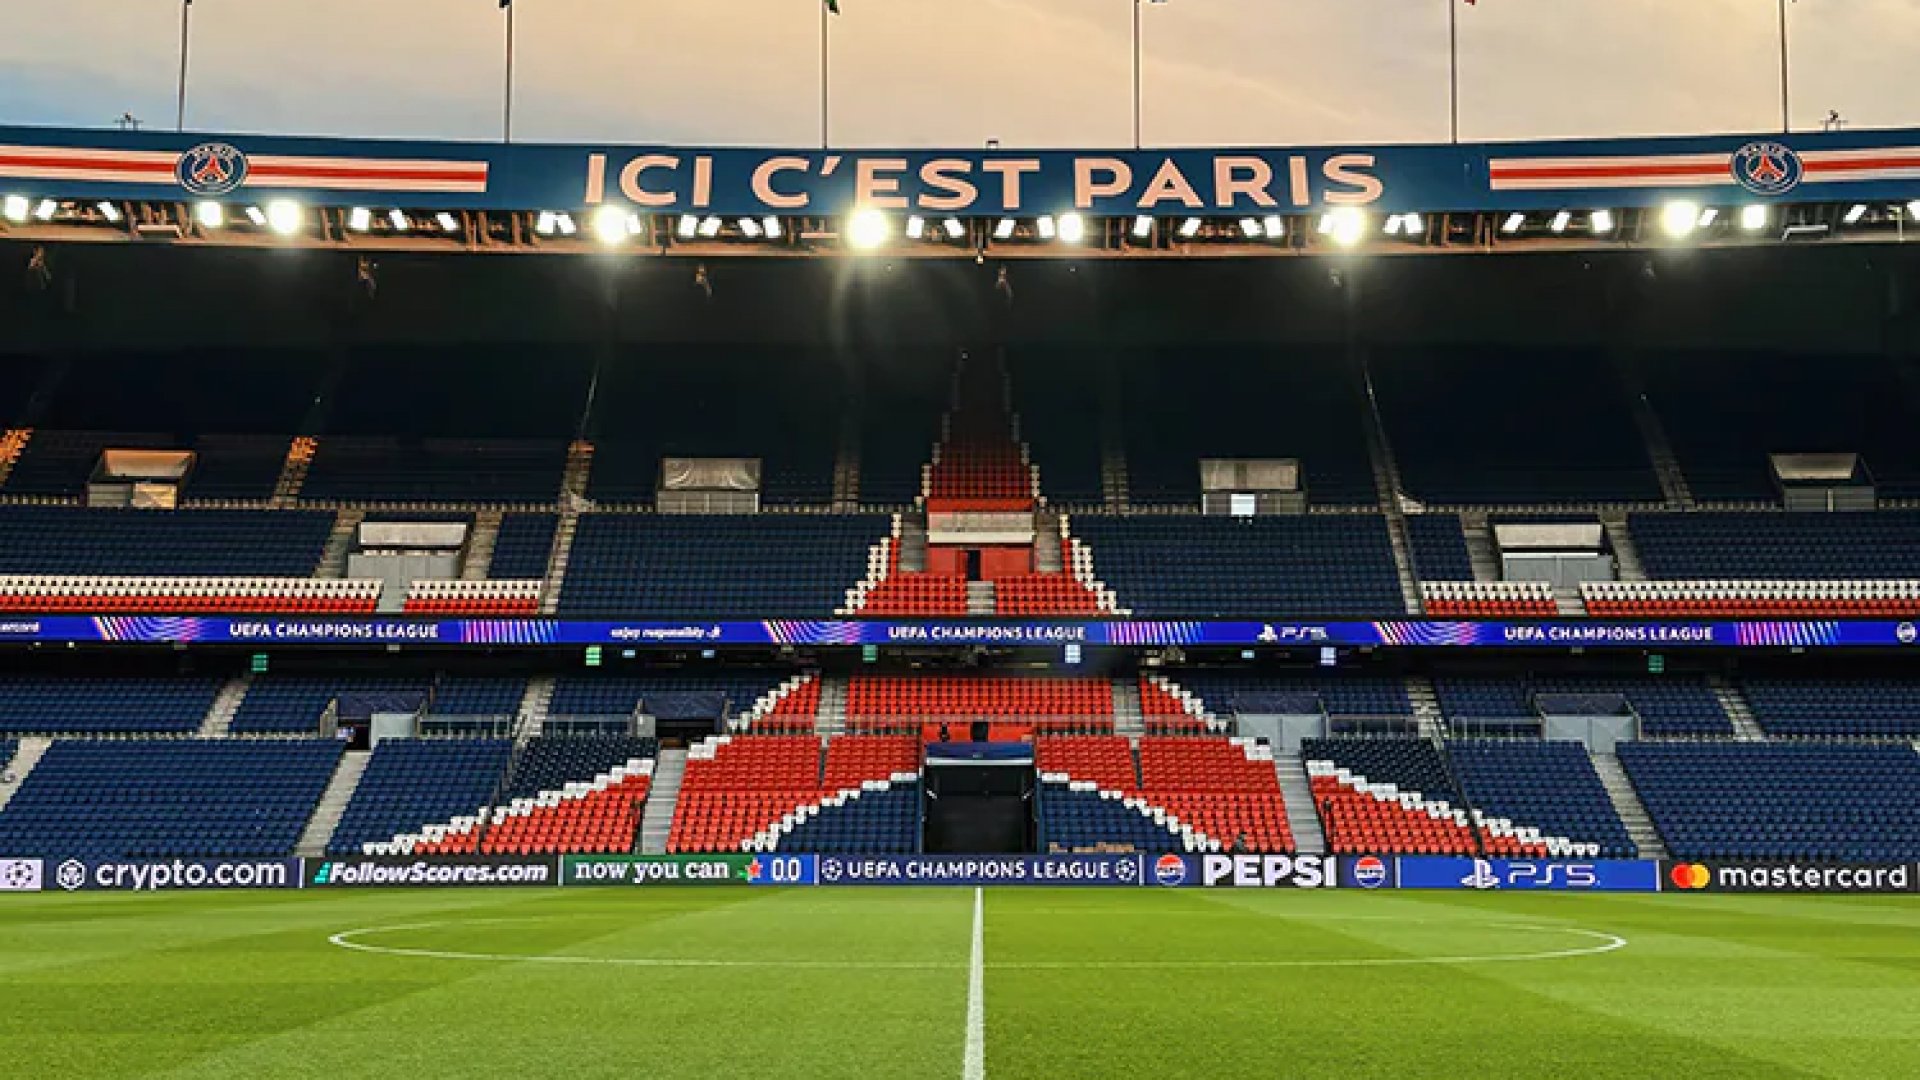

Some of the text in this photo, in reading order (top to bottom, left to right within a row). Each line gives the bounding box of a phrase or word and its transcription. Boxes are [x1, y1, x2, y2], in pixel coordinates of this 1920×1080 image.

[585, 152, 712, 206] ICI
[1073, 154, 1384, 208] PARIS
[229, 623, 438, 638] UEFA CHAMPIONS LEAGUE
[888, 626, 1085, 640] UEFA CHAMPIONS LEAGUE
[1504, 626, 1712, 641] UEFA CHAMPIONS LEAGUE
[96, 859, 286, 890] crypto.com
[329, 861, 549, 884] FollowScores.com
[575, 861, 730, 884] now you can
[847, 861, 1110, 879] UEFA CHAMPIONS LEAGUE
[1203, 854, 1337, 887] PEPSI
[1509, 864, 1597, 885] PS5
[1719, 864, 1908, 889] mastercard
